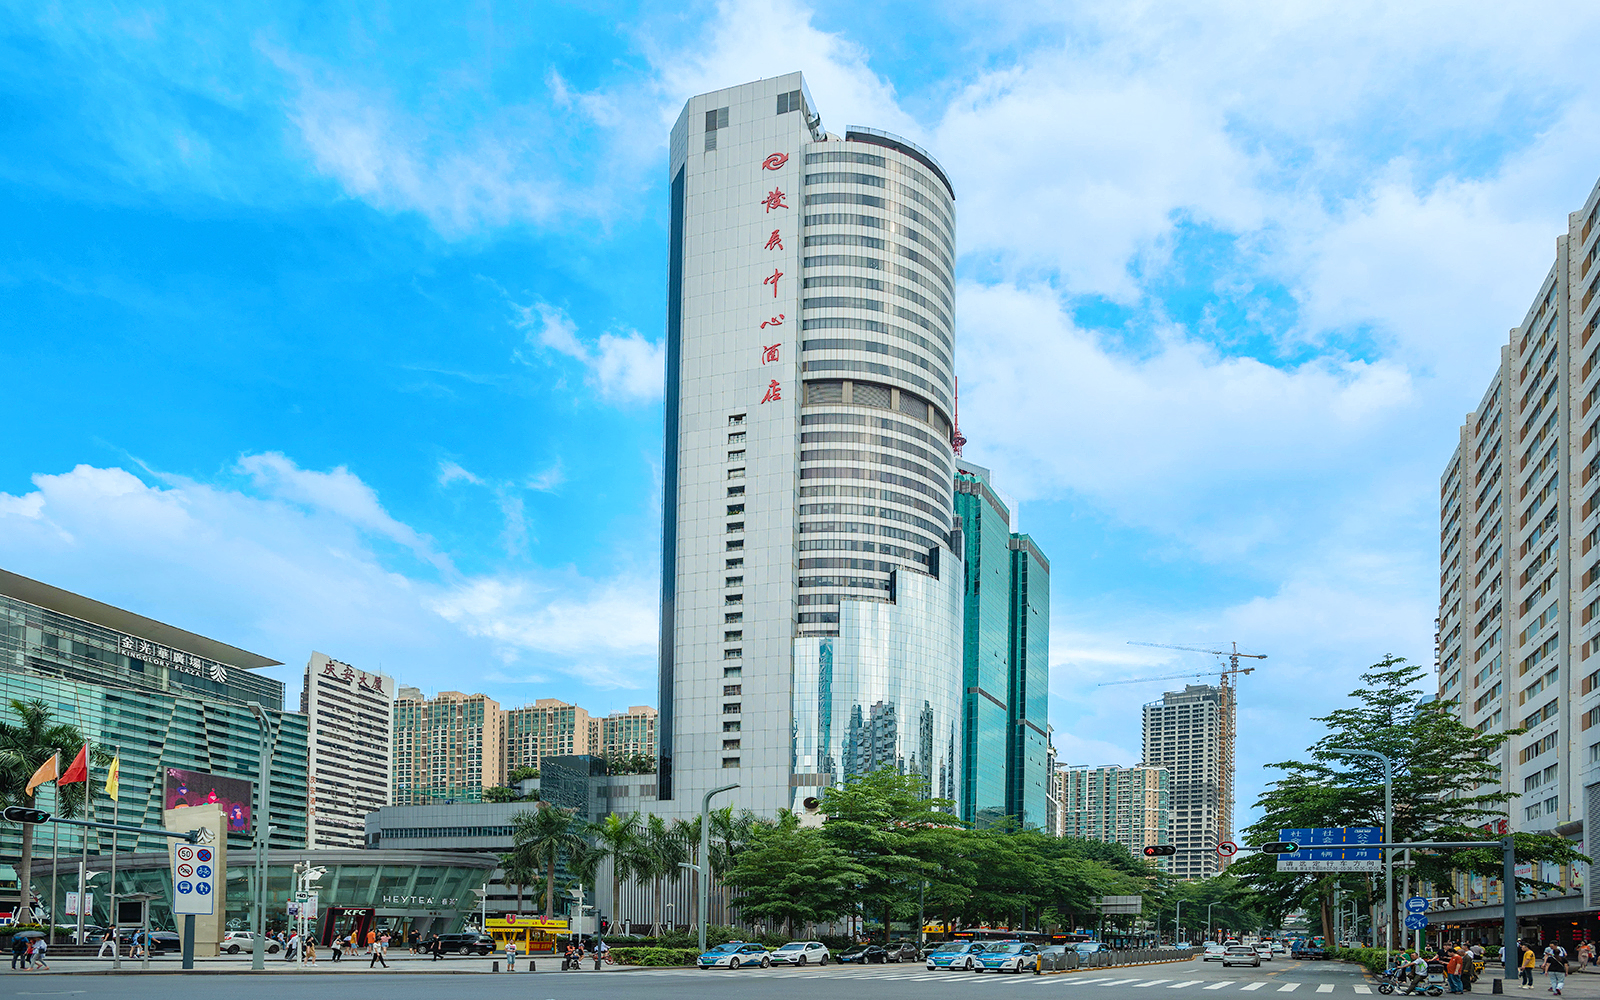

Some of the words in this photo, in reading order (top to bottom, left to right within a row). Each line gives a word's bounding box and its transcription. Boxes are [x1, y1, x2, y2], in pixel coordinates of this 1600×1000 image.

[121, 636, 201, 670] 金光華廣場
[121, 649, 170, 668] KINGGLORY
[174, 665, 201, 677] PLAZA
[323, 660, 385, 694] 庆安大厦
[181, 850, 191, 858] 50
[1321, 830, 1334, 857] 社会辆
[383, 895, 433, 905] HEYTEA
